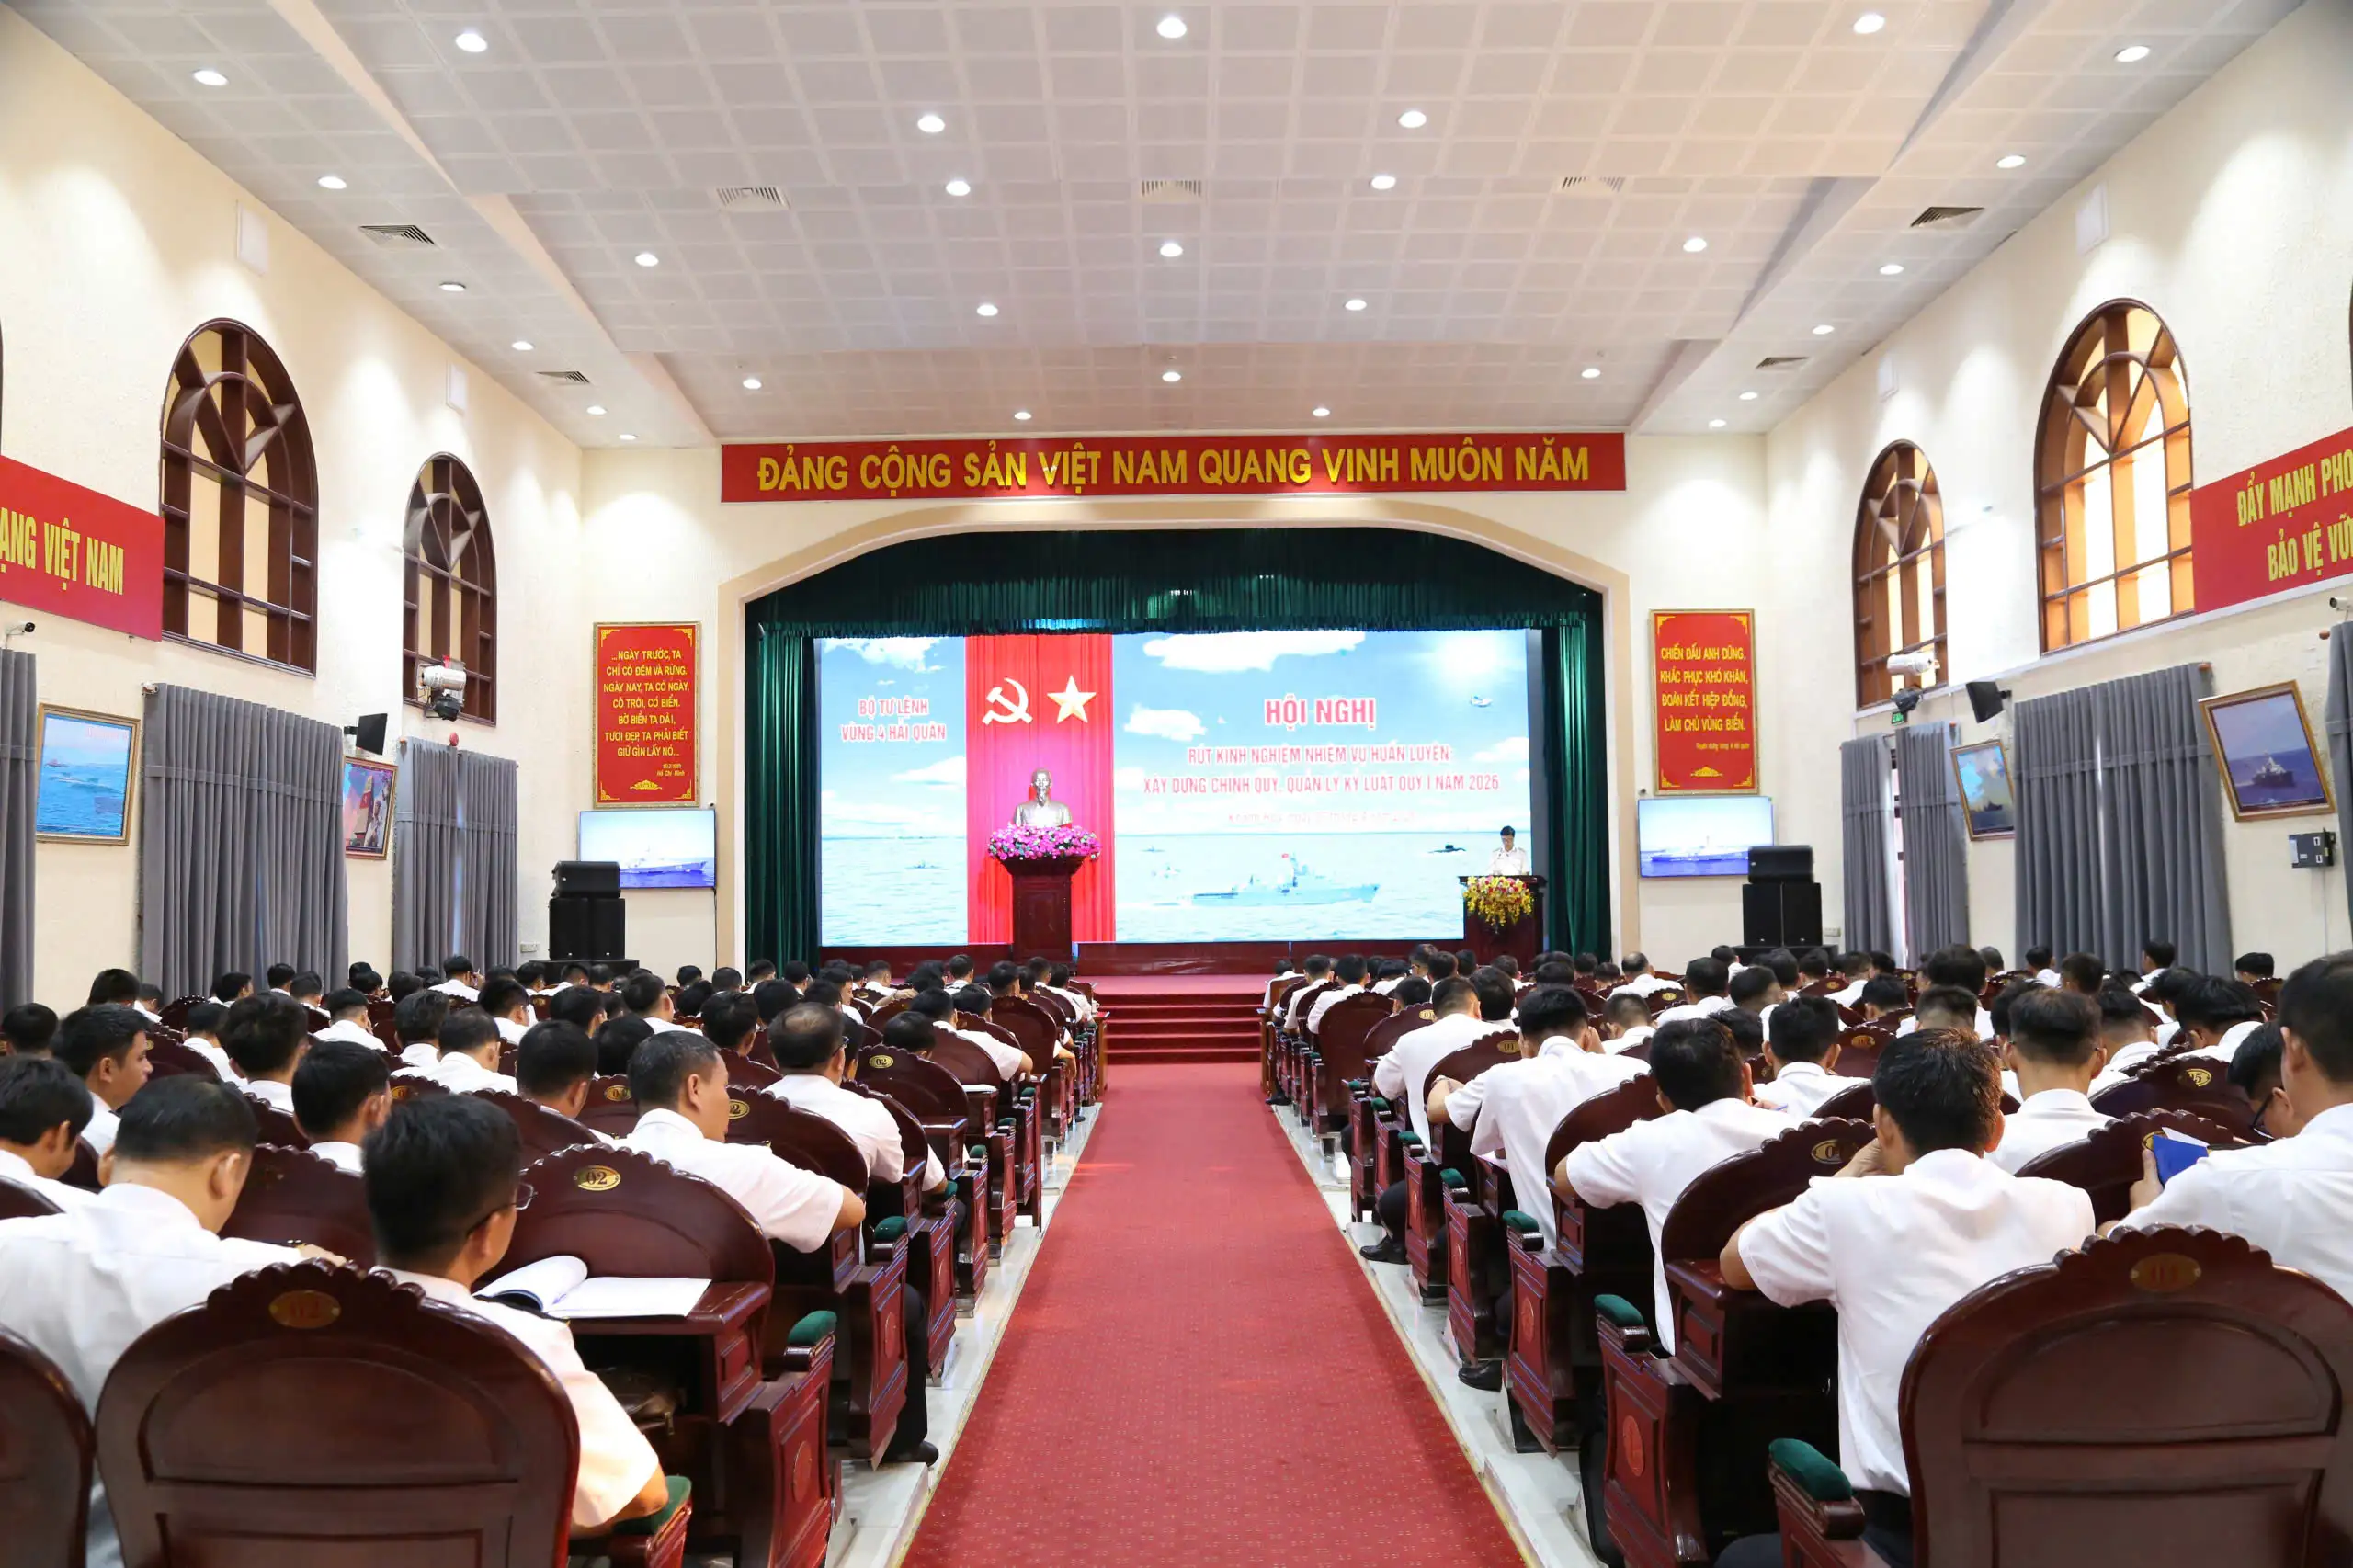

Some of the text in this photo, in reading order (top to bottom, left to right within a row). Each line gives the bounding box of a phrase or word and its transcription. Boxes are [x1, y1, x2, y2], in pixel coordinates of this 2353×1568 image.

[757, 437, 1589, 497] ĐẢNG CỘNG SẢN VIỆT NAM QUANG VINH MUÔN NĂM
[2237, 471, 2265, 527] ĐẨY
[2269, 463, 2316, 518] MẠNH
[44, 517, 81, 591] VIỆT
[85, 536, 125, 596] NAM
[2268, 528, 2298, 582] BẢO
[2302, 522, 2324, 576] VỆ
[642, 647, 671, 661] TRƯỚC,
[672, 650, 682, 660] TA
[1661, 642, 1746, 661] CHIẾN ĐẤU ANH DŨNG,
[606, 664, 620, 676] CHỈ
[622, 664, 633, 676] CÓ
[635, 665, 652, 676] ĐÊM
[654, 663, 663, 676] VÀ
[1660, 665, 1681, 683] KHẮC
[1683, 669, 1704, 687] PHỤC
[1705, 667, 1722, 683] KHÓ
[603, 680, 690, 693] NGÀY NAY, TA CÓ NGÀY,
[612, 696, 624, 709] CÓ
[648, 695, 659, 708] CÓ
[859, 695, 928, 719] BỘ TƯ LỆNH
[1661, 687, 1748, 710] ĐOÀN KẾT HIỆP ĐỒNG,
[618, 712, 629, 724] BỜ
[631, 710, 648, 724] BIỂN
[649, 715, 658, 724] TA
[1265, 694, 1376, 731] HỘI NGHỊ
[841, 717, 947, 741] VÙNG 4 HẢI QUÂN
[1665, 715, 1682, 732] LÀM
[1684, 714, 1699, 732] CHỦ
[1701, 714, 1722, 731] VÙNG
[604, 731, 623, 742] TƯƠI
[642, 731, 652, 741] TA
[654, 727, 671, 741] PHẢI
[672, 725, 688, 740] BIẾT
[617, 744, 631, 757] GIỮ
[632, 744, 645, 756] GÌN
[646, 743, 661, 756] LẤY
[1216, 747, 1246, 765] KINH
[1469, 774, 1499, 790] 2026
[875, 1058, 887, 1066] 02
[585, 1171, 608, 1185] 02
